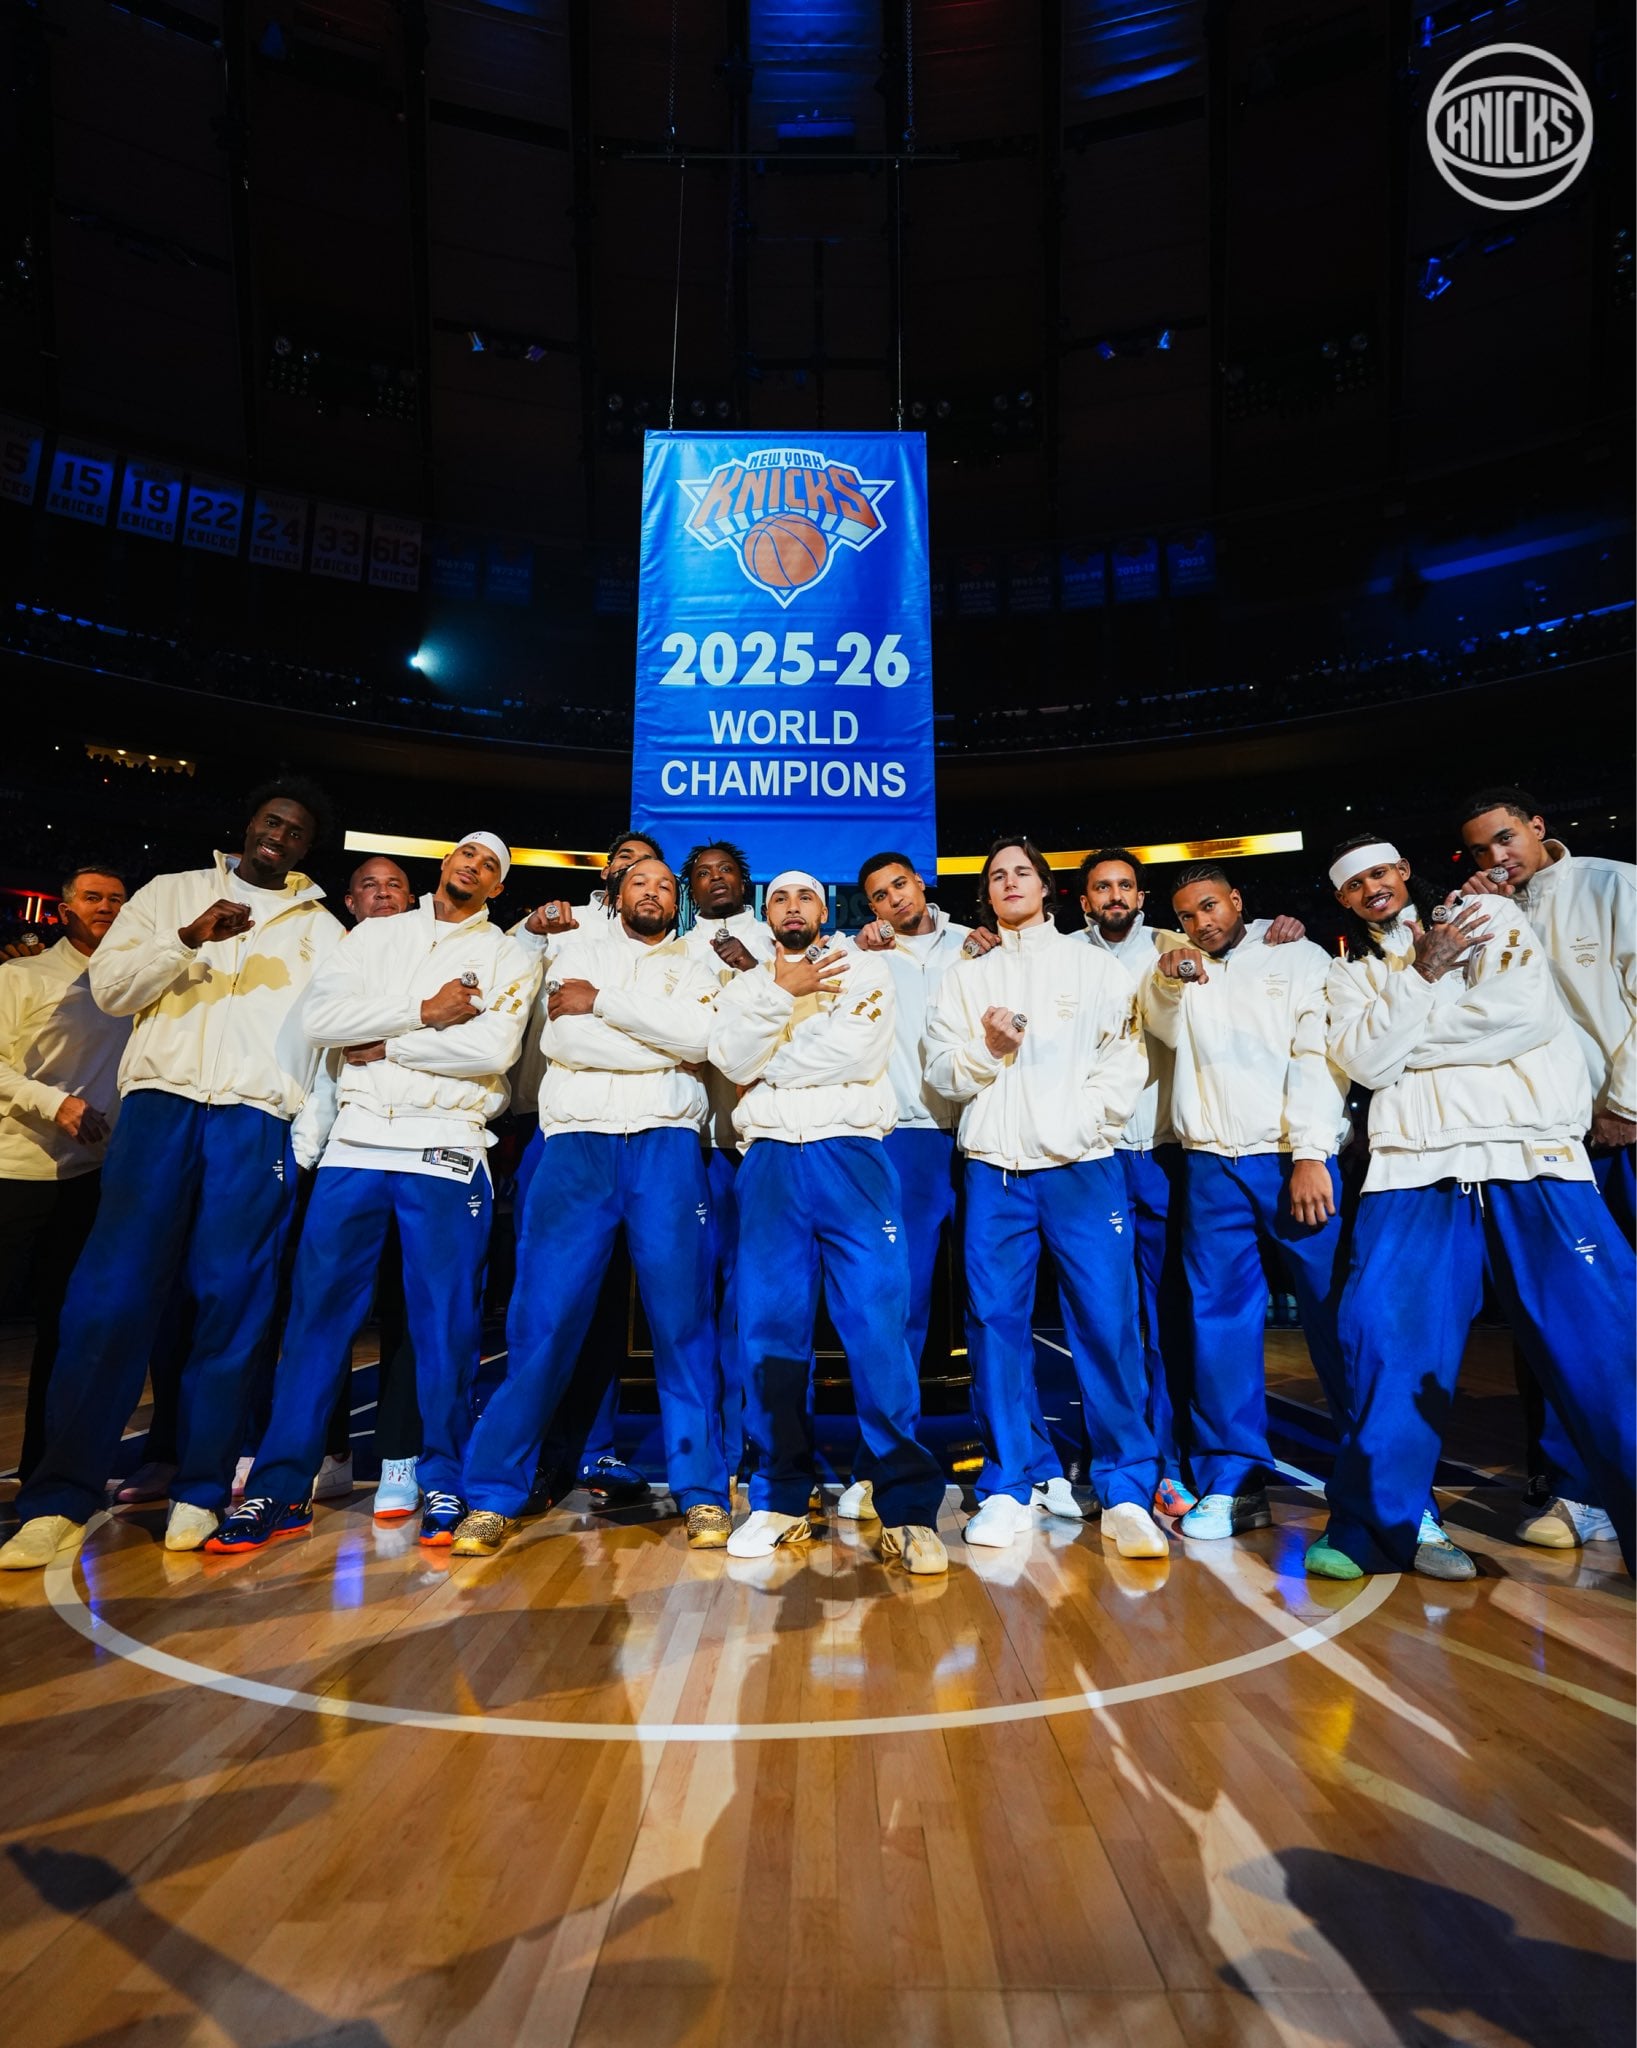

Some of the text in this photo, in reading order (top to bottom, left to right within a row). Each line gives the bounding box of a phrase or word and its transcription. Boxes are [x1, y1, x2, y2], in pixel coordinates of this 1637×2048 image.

[748, 452, 824, 470] NEW YORK
[60, 461, 104, 497] 15
[50, 492, 105, 520] KNICKS
[130, 479, 170, 513] 19
[691, 465, 878, 530] KNICKS
[120, 511, 174, 536] KNICKS
[190, 495, 238, 531] 22
[255, 512, 300, 547] 24
[186, 527, 237, 551] KNICKS
[251, 546, 300, 565] KNICKS
[317, 525, 361, 558] 33
[373, 535, 419, 568] 613
[313, 556, 361, 576] KNICKS
[371, 567, 418, 586] KNICKS
[658, 631, 910, 688] 2025-26
[708, 709, 859, 745] WORLD
[660, 760, 907, 798] CHAMPIONS
